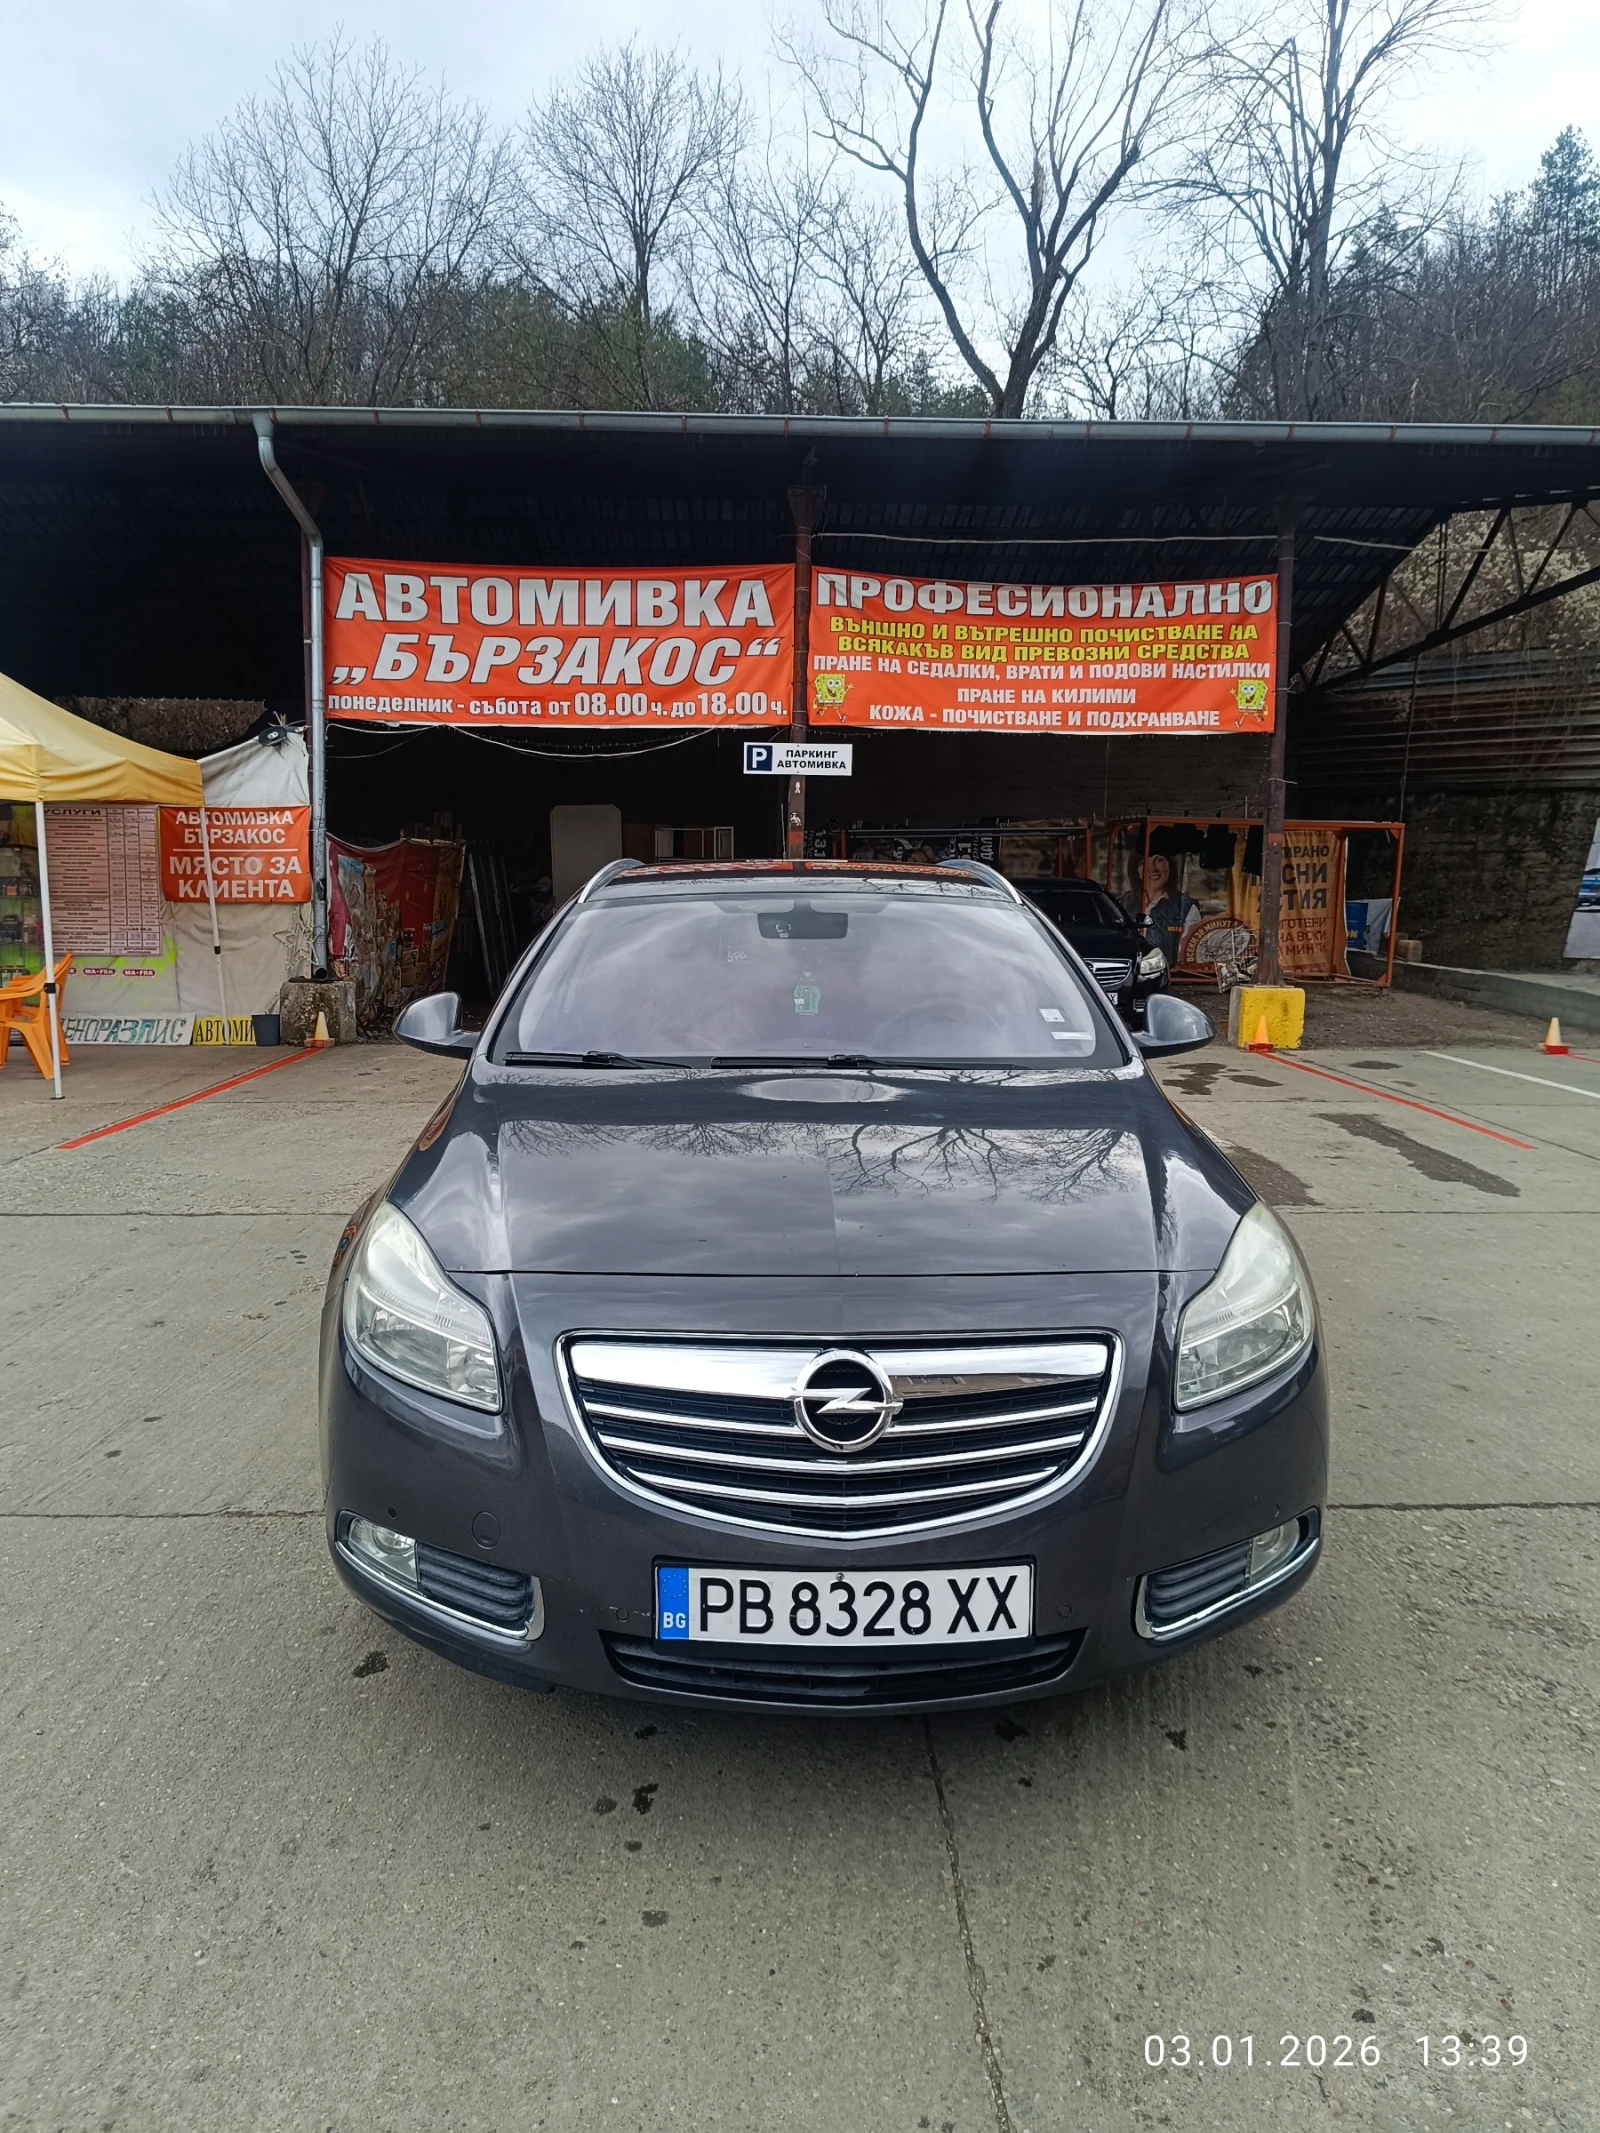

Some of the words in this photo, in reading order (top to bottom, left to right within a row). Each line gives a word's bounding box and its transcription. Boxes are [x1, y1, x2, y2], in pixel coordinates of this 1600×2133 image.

[334, 572, 775, 627] АВТОМИВКА
[816, 571, 1273, 619] ПРОФЕСИОНАЛНО
[830, 616, 925, 639] ВЪНШНО
[932, 624, 948, 640] И
[954, 624, 1073, 643] ВЪТРЕШНО
[1080, 624, 1224, 643] ПОЧИСТВАНЕ
[1229, 624, 1259, 640] НА
[838, 635, 954, 659] ВСЯКАКЪВ
[961, 644, 1008, 663] ВИД
[1014, 645, 1130, 662] ПРЕВОЗНИ
[1137, 643, 1250, 661] СРЕДСТВА
[814, 655, 872, 672] ПРАНЕ
[877, 657, 902, 674] НА
[907, 661, 1000, 681] СЕДАЛКИ,
[1006, 664, 1064, 680] ВРАТИ
[1070, 665, 1083, 680] И
[1089, 663, 1166, 680] ПОДОВИ
[1172, 662, 1270, 679] НАСТИЛКИ
[328, 694, 454, 714] понеделник
[469, 698, 542, 715] събота
[548, 701, 571, 716] от
[574, 691, 648, 716] 08.00
[670, 701, 696, 718] до
[697, 691, 768, 716] 18.00
[771, 701, 788, 716] ч.
[957, 687, 1016, 704] ПРАНЕ
[1021, 688, 1047, 704] НА
[1052, 688, 1136, 704] КИЛИМИ
[869, 704, 925, 722] КОЖА
[942, 709, 1062, 726] ПОЧИСТВАНЕ
[1068, 710, 1081, 726] И
[1086, 710, 1220, 728] ПОДХРАНВАНЕ
[777, 760, 846, 769] АВТОМИВКА
[786, 749, 838, 759] ПАРКИНГ
[1282, 845, 1330, 858] ИРАНО
[169, 856, 263, 876] МЯСТО
[269, 856, 303, 875] ЗА
[178, 879, 295, 899] КЛИЕНТА
[699, 1577, 774, 1635] PB
[788, 1579, 932, 1638] 8328
[946, 1574, 1018, 1634] XX
[662, 1612, 687, 1630] BG
